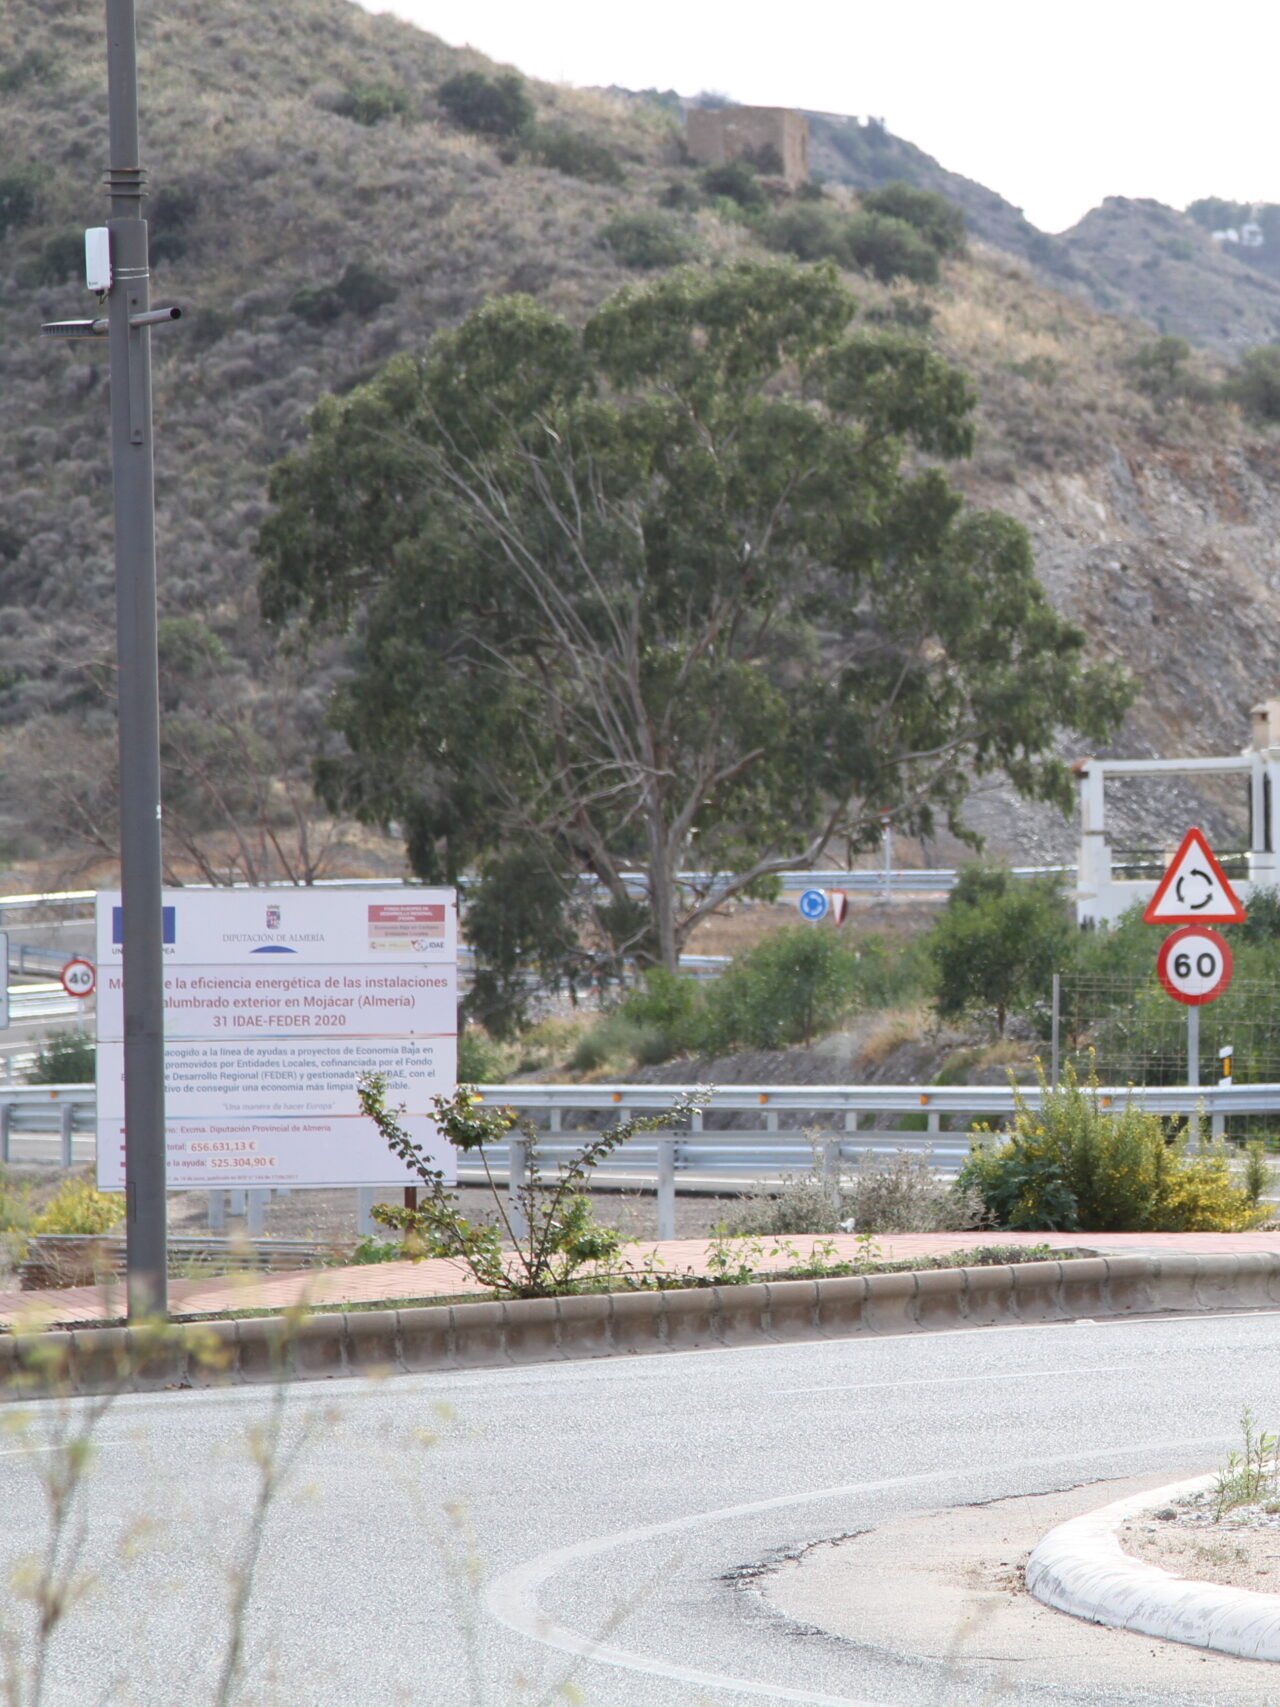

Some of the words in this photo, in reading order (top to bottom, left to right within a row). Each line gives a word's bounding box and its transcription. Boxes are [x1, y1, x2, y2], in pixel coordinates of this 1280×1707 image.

[223, 933, 274, 942] DIPUTACIÓN
[289, 933, 324, 942] ALMERÍA
[1174, 952, 1216, 978] 60
[70, 970, 90, 985] 40
[176, 978, 187, 989] la
[191, 977, 251, 989] eficiencia
[255, 976, 320, 991] energética
[325, 976, 340, 988] de
[344, 976, 361, 988] las
[366, 975, 448, 988] instalaciones
[233, 997, 281, 1008] exterior
[285, 998, 300, 1007] en
[304, 996, 353, 1010] Mojácar
[358, 994, 415, 1009] (Almería)
[213, 1016, 227, 1027] 31
[233, 1015, 310, 1026] IDAE-FEDER
[315, 1015, 346, 1026] 2020
[164, 1048, 199, 1057] acogido
[210, 1048, 218, 1056] la
[220, 1047, 240, 1056] línea
[244, 1047, 254, 1055] de
[257, 1048, 287, 1057] ayudas
[298, 1047, 340, 1057] proyectos
[343, 1046, 353, 1055] de
[356, 1046, 398, 1055] Economía
[402, 1046, 420, 1055] Baja
[165, 1060, 217, 1069] promovidos
[220, 1062, 234, 1070] por
[237, 1059, 280, 1068] Entidades
[282, 1059, 319, 1068] Locales,
[321, 1058, 376, 1067] cofinanciada
[379, 1060, 393, 1068] por
[396, 1058, 403, 1066] el
[406, 1057, 432, 1066] Fondo
[173, 1072, 217, 1081] Desarrollo
[220, 1072, 258, 1082] Regional
[261, 1071, 296, 1080] (FEDER)
[307, 1071, 355, 1080] gestionada
[428, 1069, 435, 1077] el
[183, 1085, 194, 1093] de
[197, 1085, 239, 1094] conseguir
[261, 1083, 303, 1091] economía
[306, 1082, 324, 1091] más
[327, 1082, 354, 1092] limpia
[210, 1126, 250, 1134] Diputación
[191, 1142, 246, 1152] 656.631,13
[249, 1142, 255, 1151] €
[182, 1160, 207, 1168] ayuda:
[211, 1158, 266, 1168] 525.304,90
[269, 1158, 275, 1166] €
